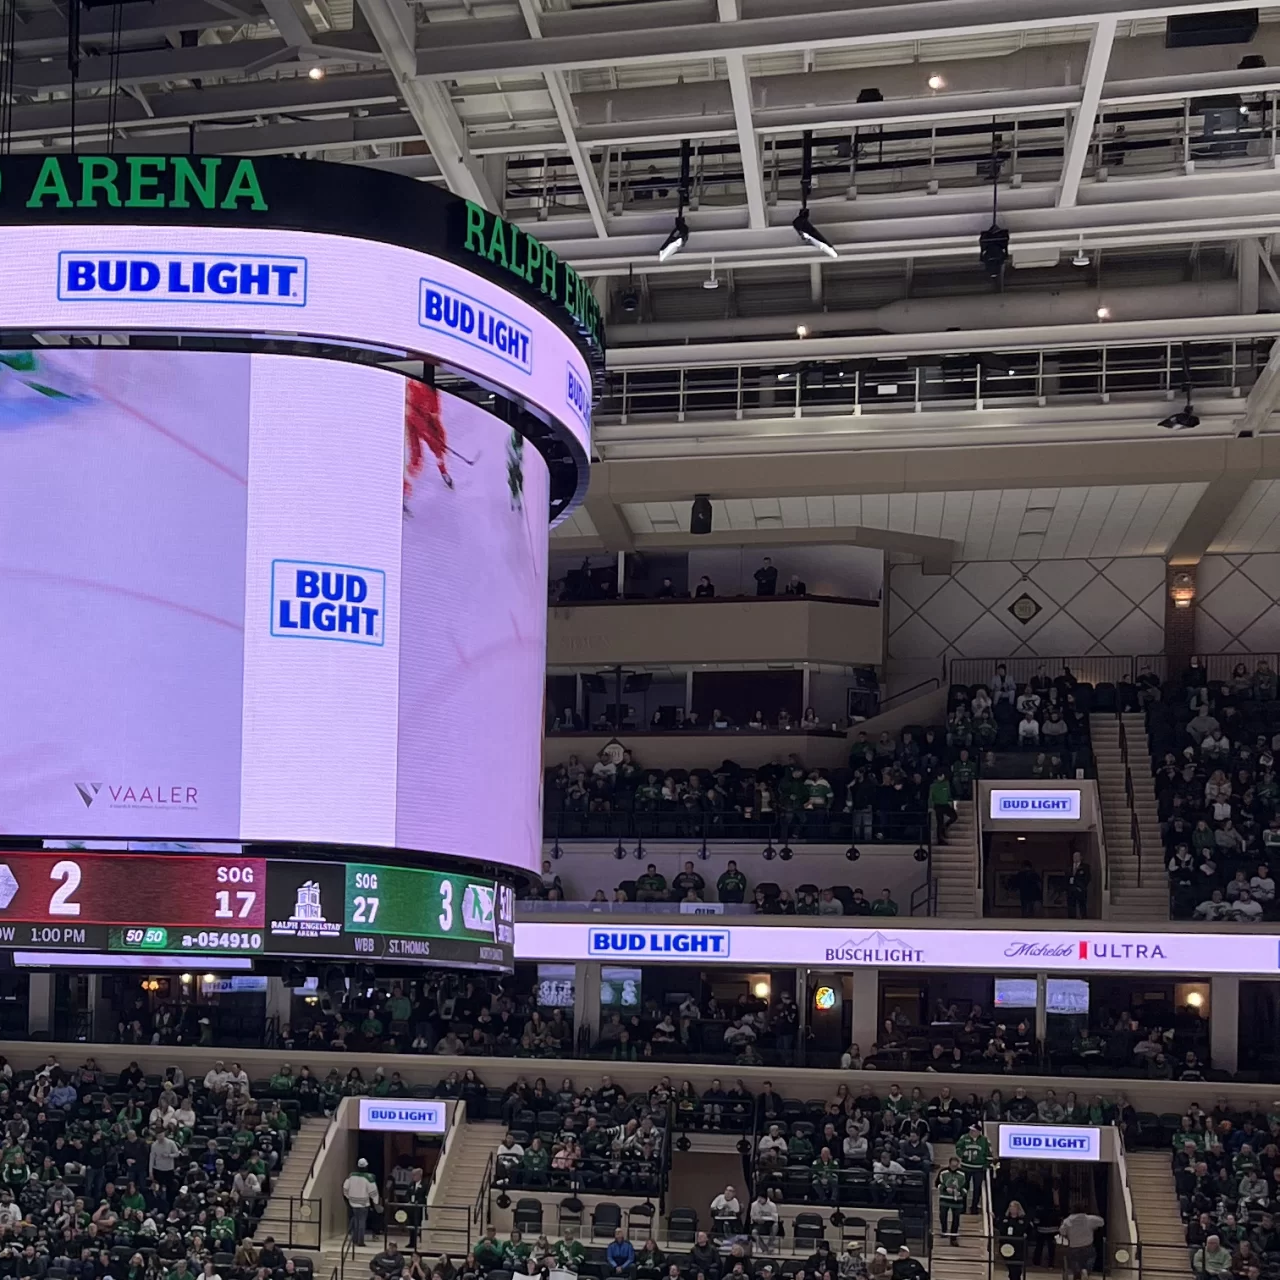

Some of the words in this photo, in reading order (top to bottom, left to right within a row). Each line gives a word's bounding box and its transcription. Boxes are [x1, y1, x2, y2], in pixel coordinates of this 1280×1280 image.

[25, 156, 268, 210] ARENA
[464, 199, 558, 300] RALPH
[67, 261, 160, 292] BUD
[168, 262, 298, 297] LIGHT
[425, 288, 474, 334] BUD
[478, 312, 529, 364] LIGHT
[296, 569, 368, 603] BUD
[279, 600, 379, 637] LIGHT
[109, 785, 198, 803] VAALER
[1003, 800, 1029, 809] BUD
[1032, 800, 1068, 809] LIGHT
[217, 867, 254, 883] SOG
[355, 873, 377, 889] SOG
[49, 860, 82, 915] 2
[215, 891, 256, 918] 17
[353, 896, 379, 923] 27
[438, 880, 453, 931] 3
[30, 927, 60, 942] 1:00
[64, 928, 85, 943] PM
[271, 921, 298, 929] RALPH
[300, 922, 341, 931] ENGELSTAD
[126, 930, 142, 942] 50
[146, 931, 163, 942] 50
[182, 932, 262, 949] a-054910
[594, 933, 645, 951] BUD
[650, 935, 724, 953] LIGHT
[354, 938, 375, 951] WBB
[402, 941, 430, 954] THOMAS
[1004, 942, 1073, 957] Michelob
[1093, 944, 1166, 959] ULTRA
[371, 1110, 396, 1120] BUD
[398, 1112, 433, 1121] LIGHT
[1013, 1137, 1042, 1147] BUD
[1045, 1138, 1086, 1148] LIGHT
